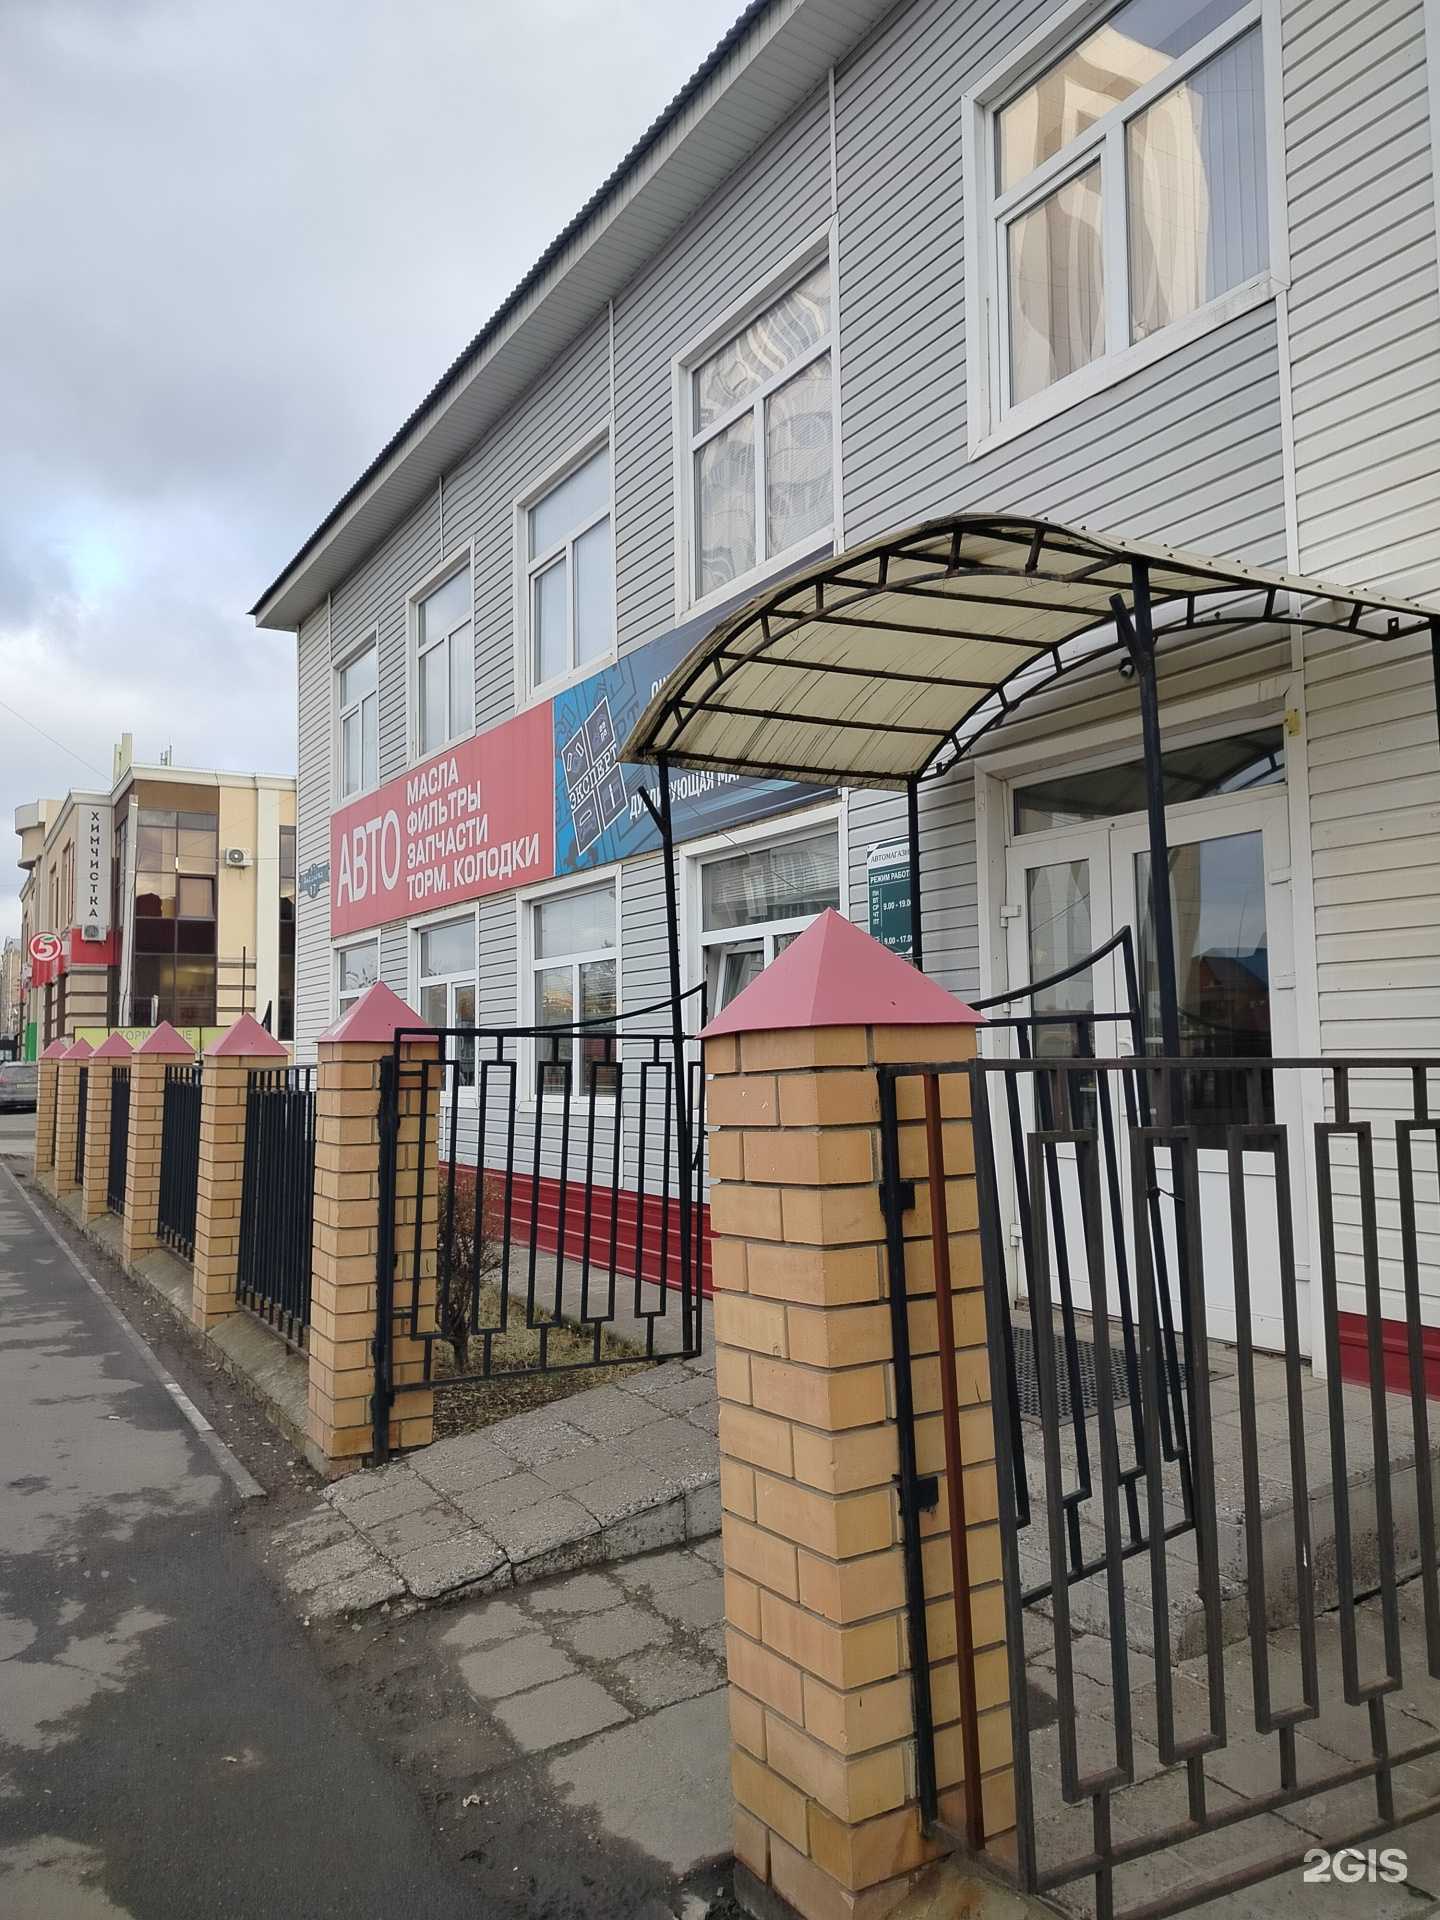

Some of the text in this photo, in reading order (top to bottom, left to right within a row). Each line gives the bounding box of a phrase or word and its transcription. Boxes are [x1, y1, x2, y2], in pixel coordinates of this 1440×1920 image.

[406, 757, 459, 805] МАСЛА
[568, 743, 617, 810] ЭКСПЕРТ
[406, 781, 481, 836] ФИЛЬТРЫ
[89, 811, 100, 918] ХИМЧИСТКА
[337, 809, 401, 907] АВТО
[406, 814, 488, 869] ЗАПЧАСТИ
[406, 833, 540, 901] ТОРМ. КОЛОДКИ
[870, 869, 911, 885] РЕЖИМ РАБОТ
